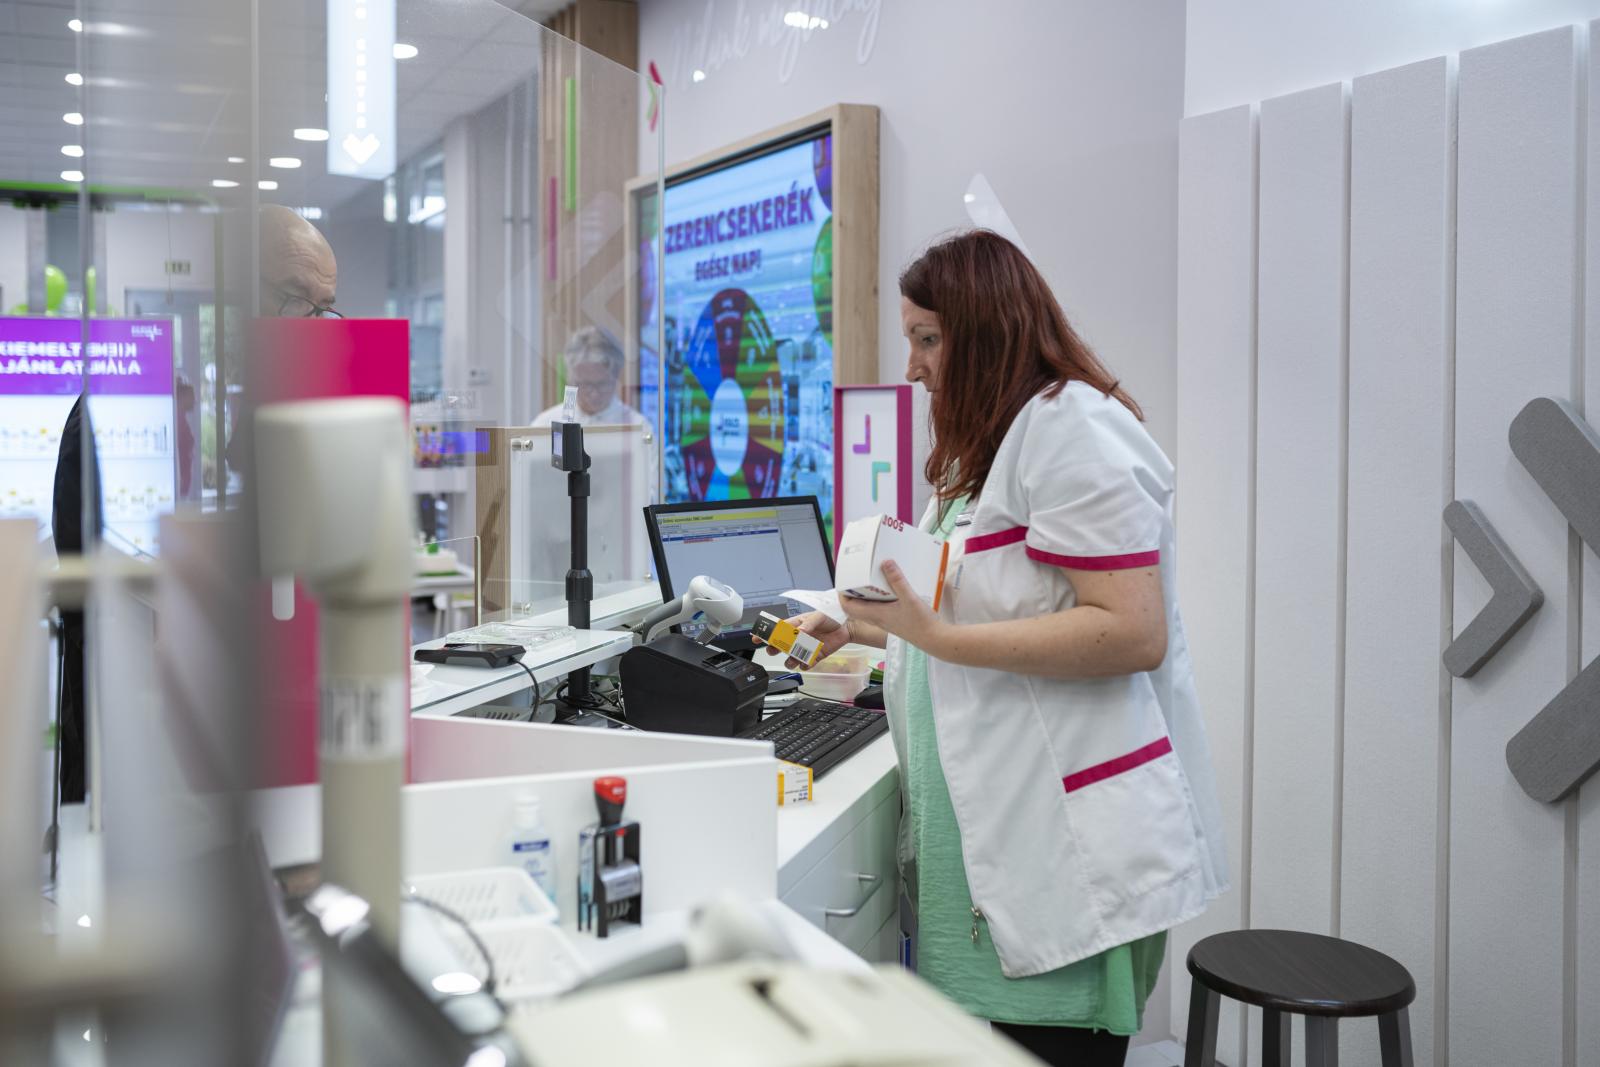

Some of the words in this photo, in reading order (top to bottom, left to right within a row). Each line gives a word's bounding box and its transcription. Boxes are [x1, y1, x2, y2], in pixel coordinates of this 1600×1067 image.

[664, 181, 814, 254] ZERENCSEKERÉK
[695, 253, 729, 281] EGÉSZ
[732, 249, 761, 274] NAP!
